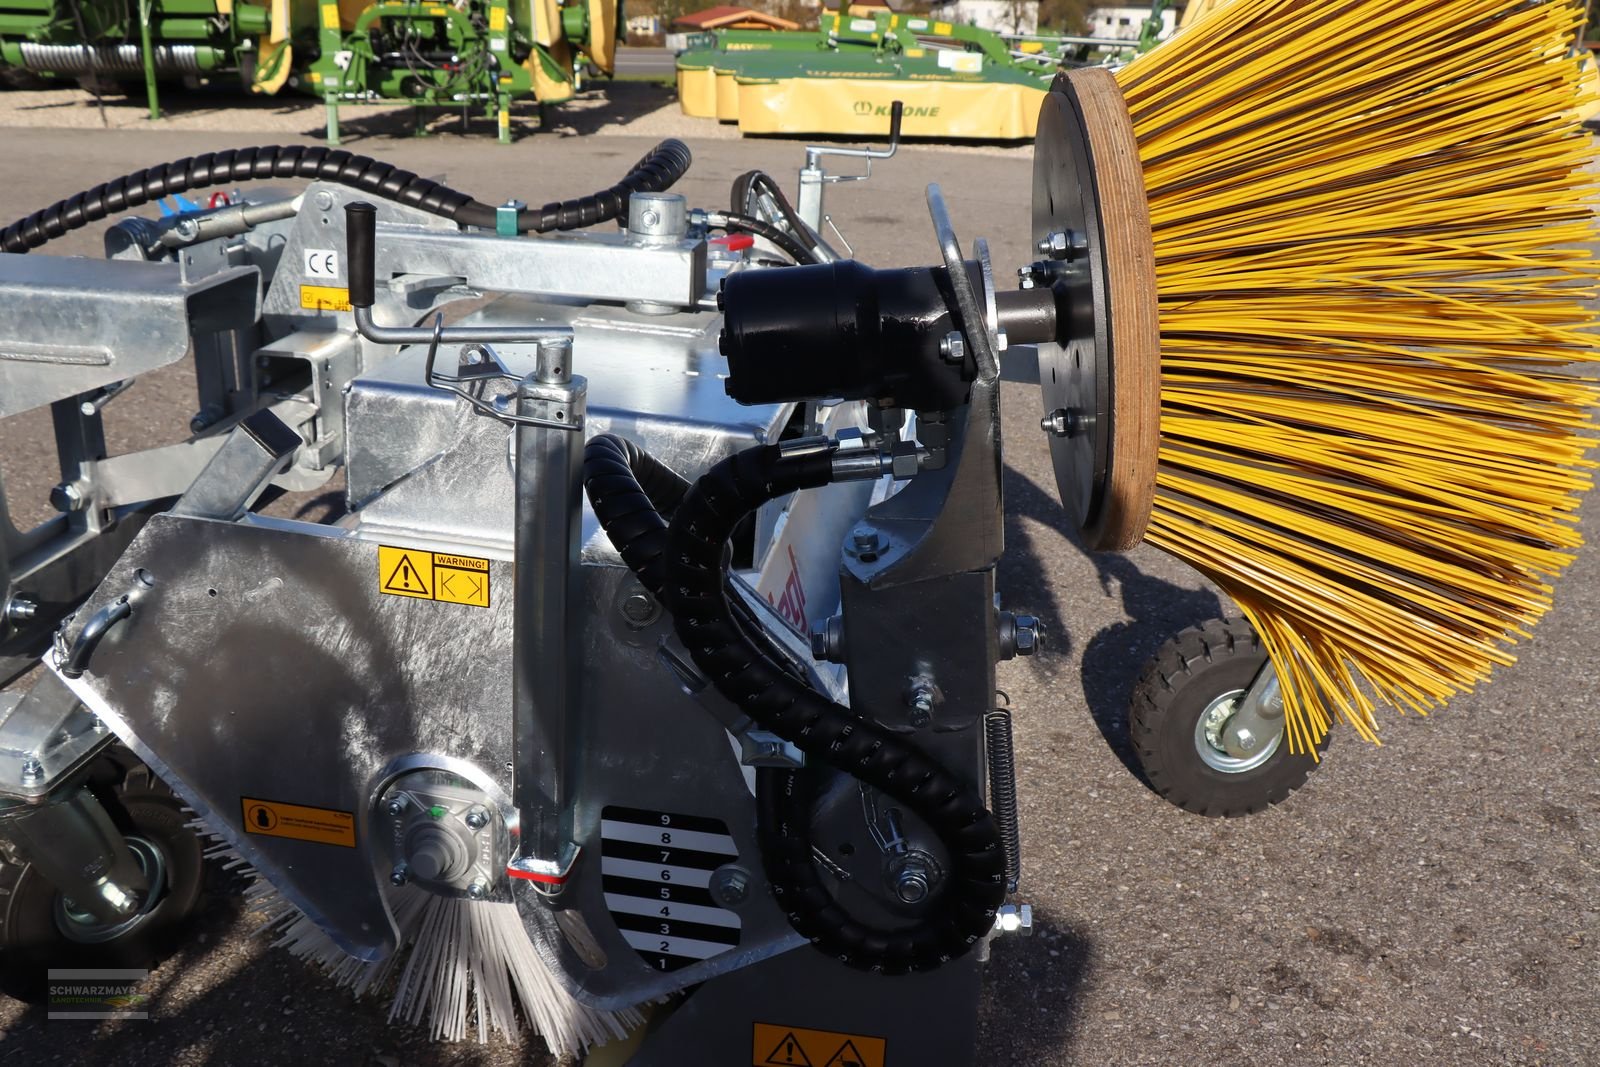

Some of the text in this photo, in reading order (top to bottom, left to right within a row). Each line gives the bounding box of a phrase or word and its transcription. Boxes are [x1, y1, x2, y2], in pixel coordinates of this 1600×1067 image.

[874, 106, 940, 117] KONE
[309, 253, 334, 274] CE
[437, 555, 485, 569] WARNING!
[661, 814, 671, 825] 9
[661, 832, 671, 844] 8
[660, 851, 670, 862] 7
[660, 869, 671, 881] 6
[660, 888, 670, 899] 5
[660, 906, 670, 917] 4
[660, 923, 670, 934] 3
[660, 941, 670, 952] 2
[659, 958, 666, 969] 1
